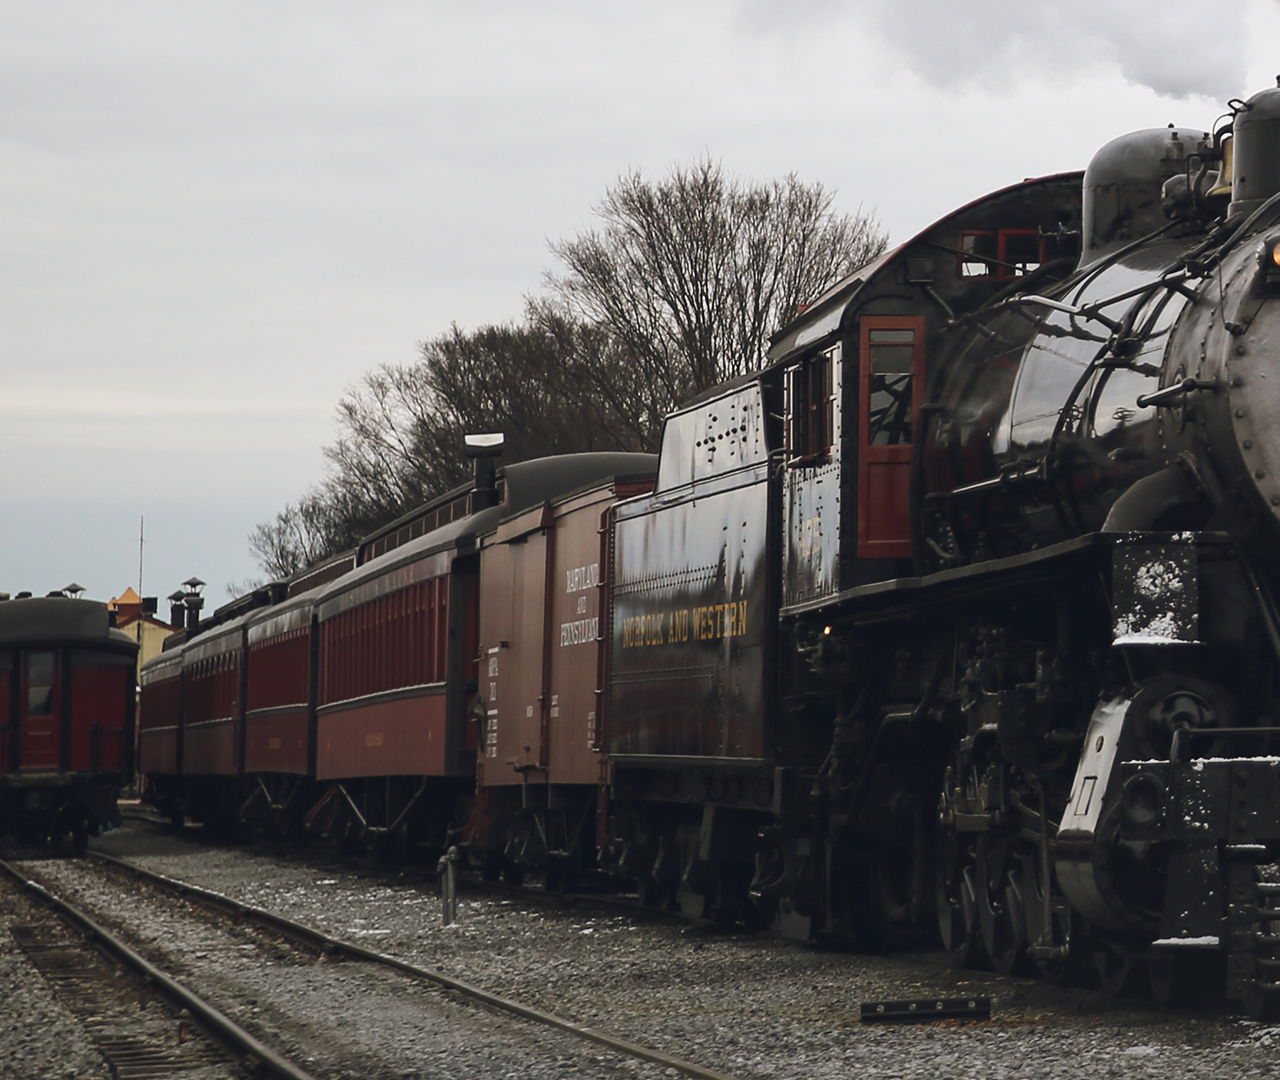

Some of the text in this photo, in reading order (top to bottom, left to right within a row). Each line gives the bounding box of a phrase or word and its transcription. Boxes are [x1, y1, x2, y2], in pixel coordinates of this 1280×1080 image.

[623, 600, 748, 648] NORFOLK AND WESTERN
